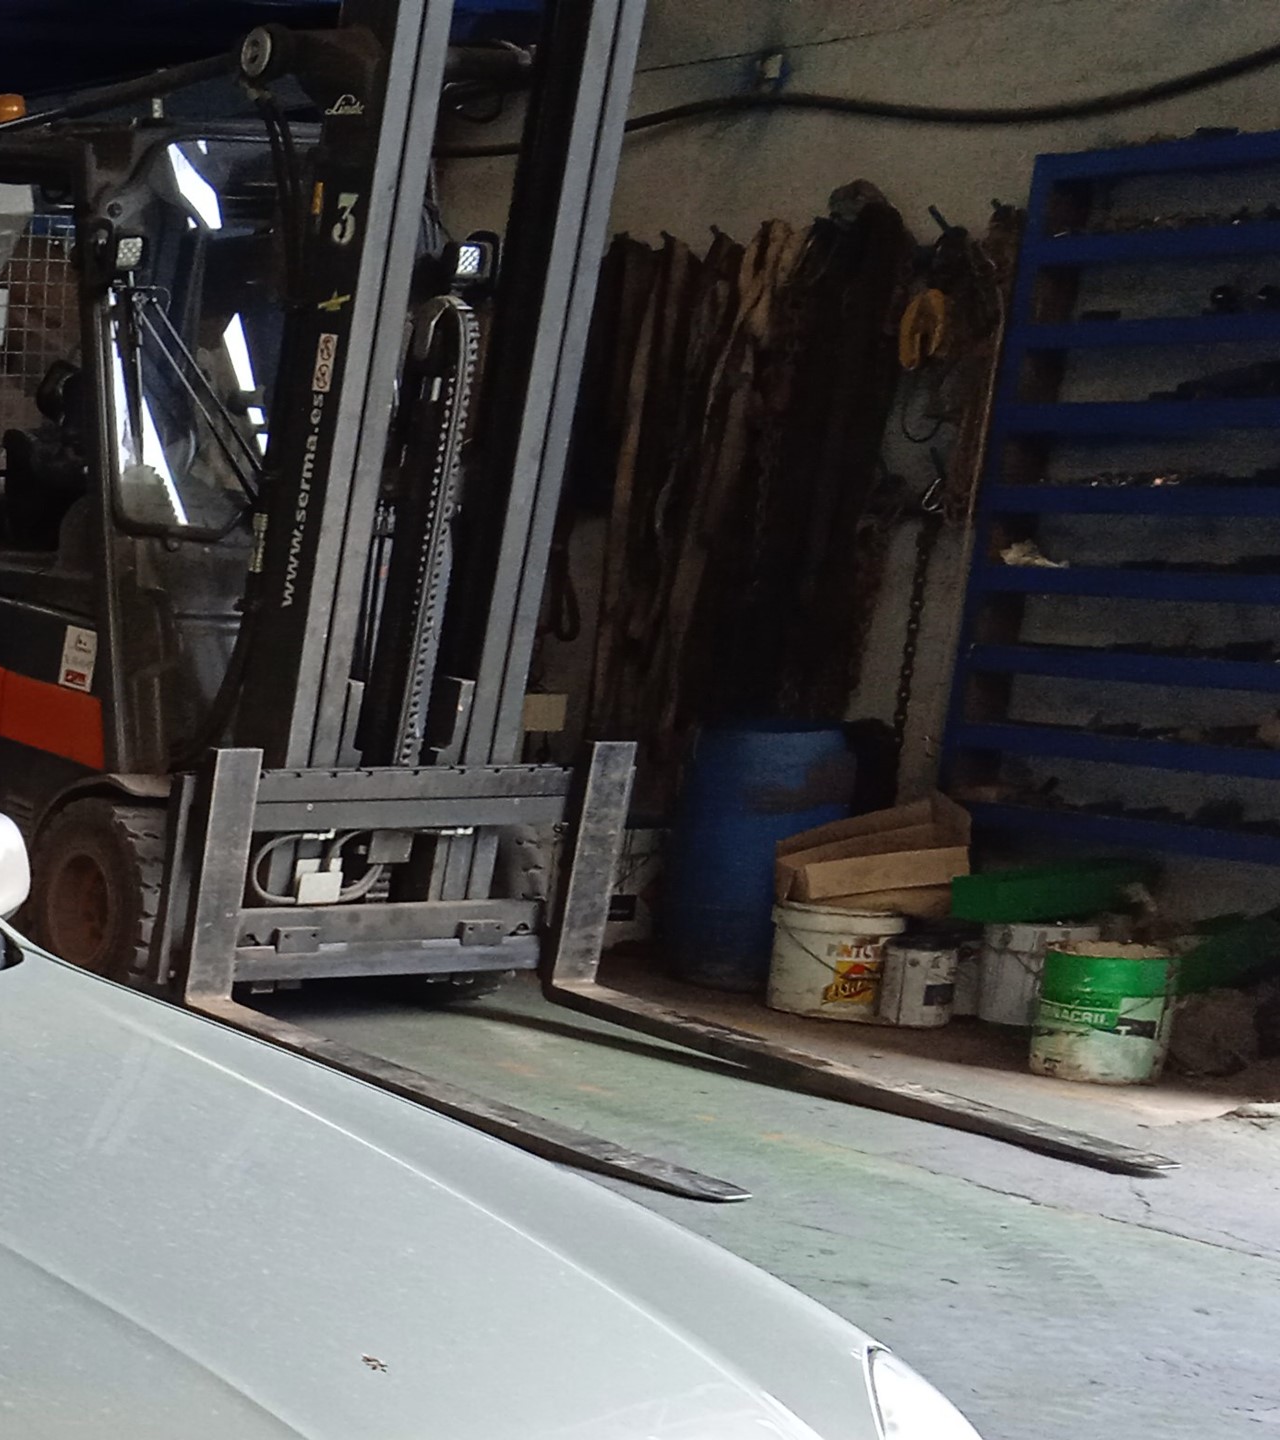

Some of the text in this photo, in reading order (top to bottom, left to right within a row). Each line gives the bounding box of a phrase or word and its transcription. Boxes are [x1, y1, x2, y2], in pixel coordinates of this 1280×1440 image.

[325, 94, 365, 115] Linde
[331, 193, 359, 245] 3
[281, 392, 325, 608] www.serma.es
